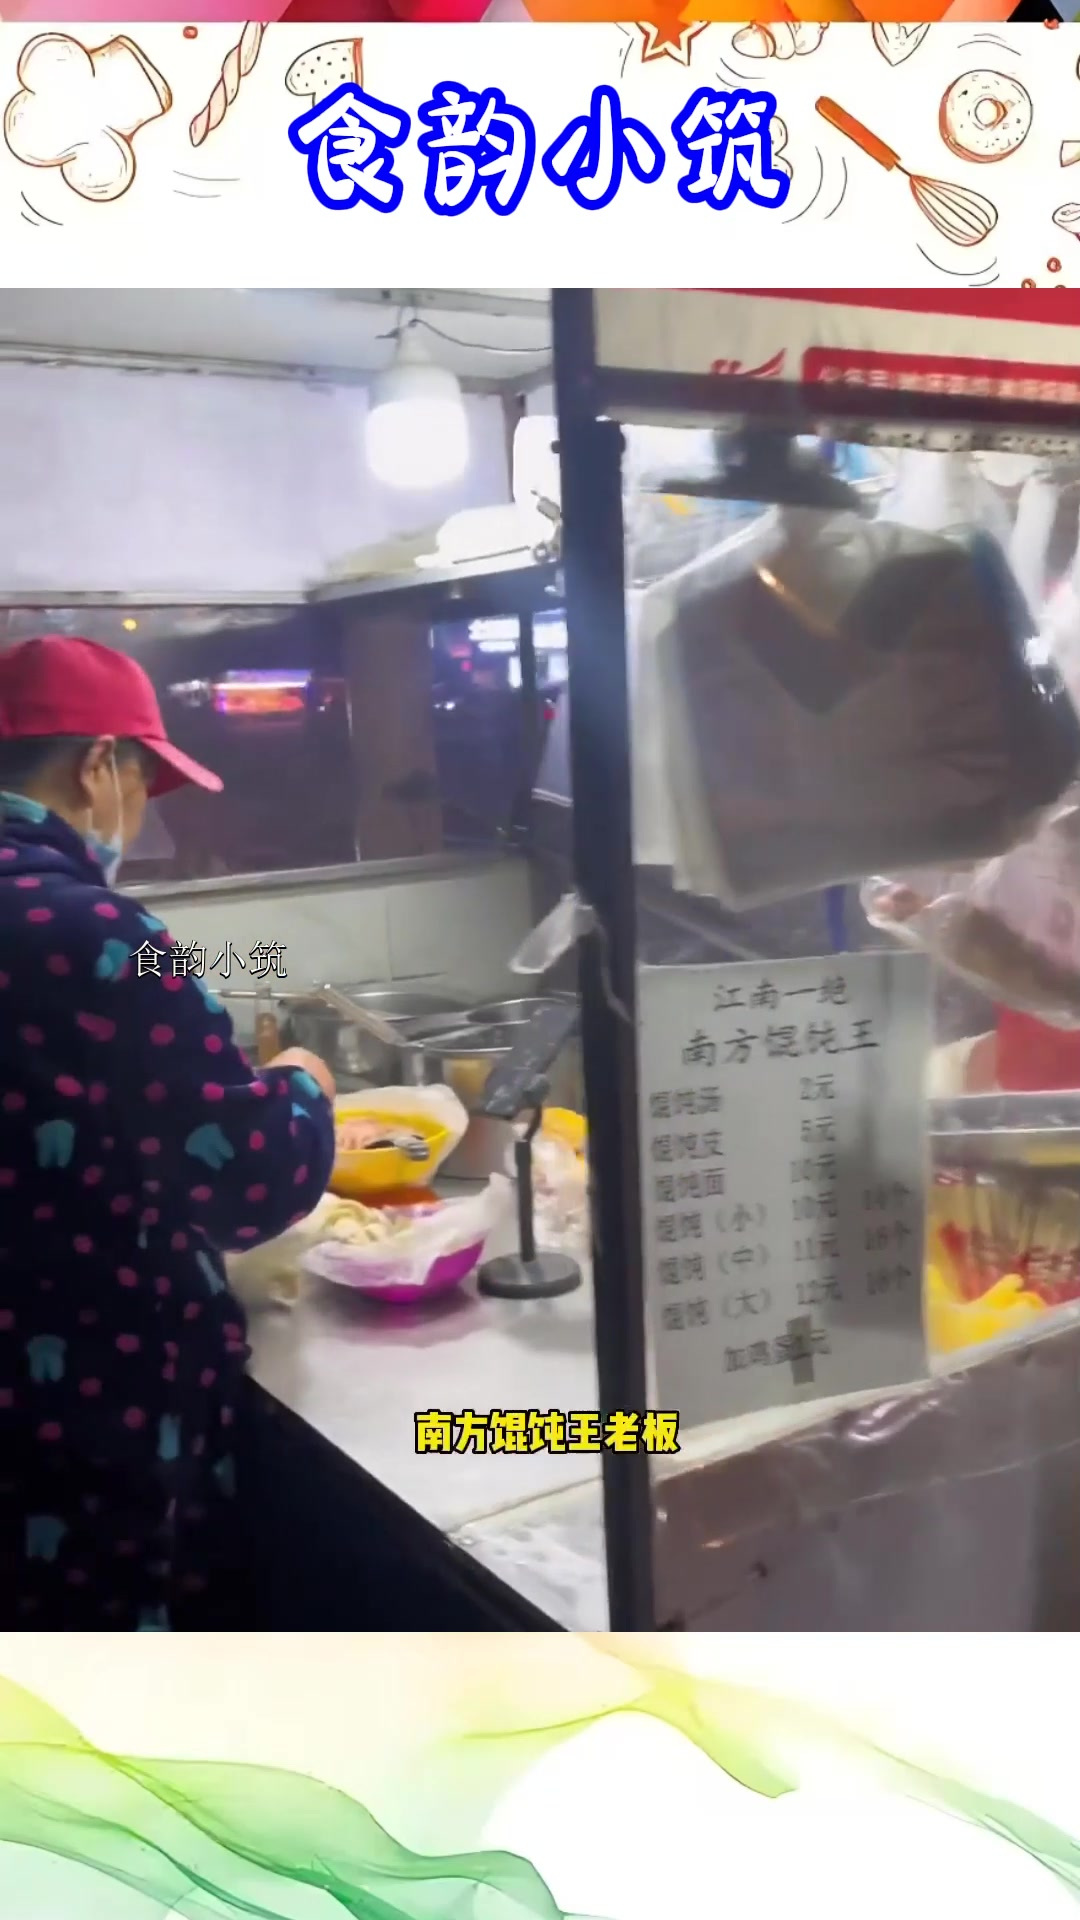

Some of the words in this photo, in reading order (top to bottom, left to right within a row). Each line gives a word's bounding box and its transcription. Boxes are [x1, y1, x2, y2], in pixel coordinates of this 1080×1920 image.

[713, 976, 848, 1012] 江南一绝
[681, 1019, 880, 1067] 南方馄饨王
[655, 1167, 726, 1203] 馄饨面
